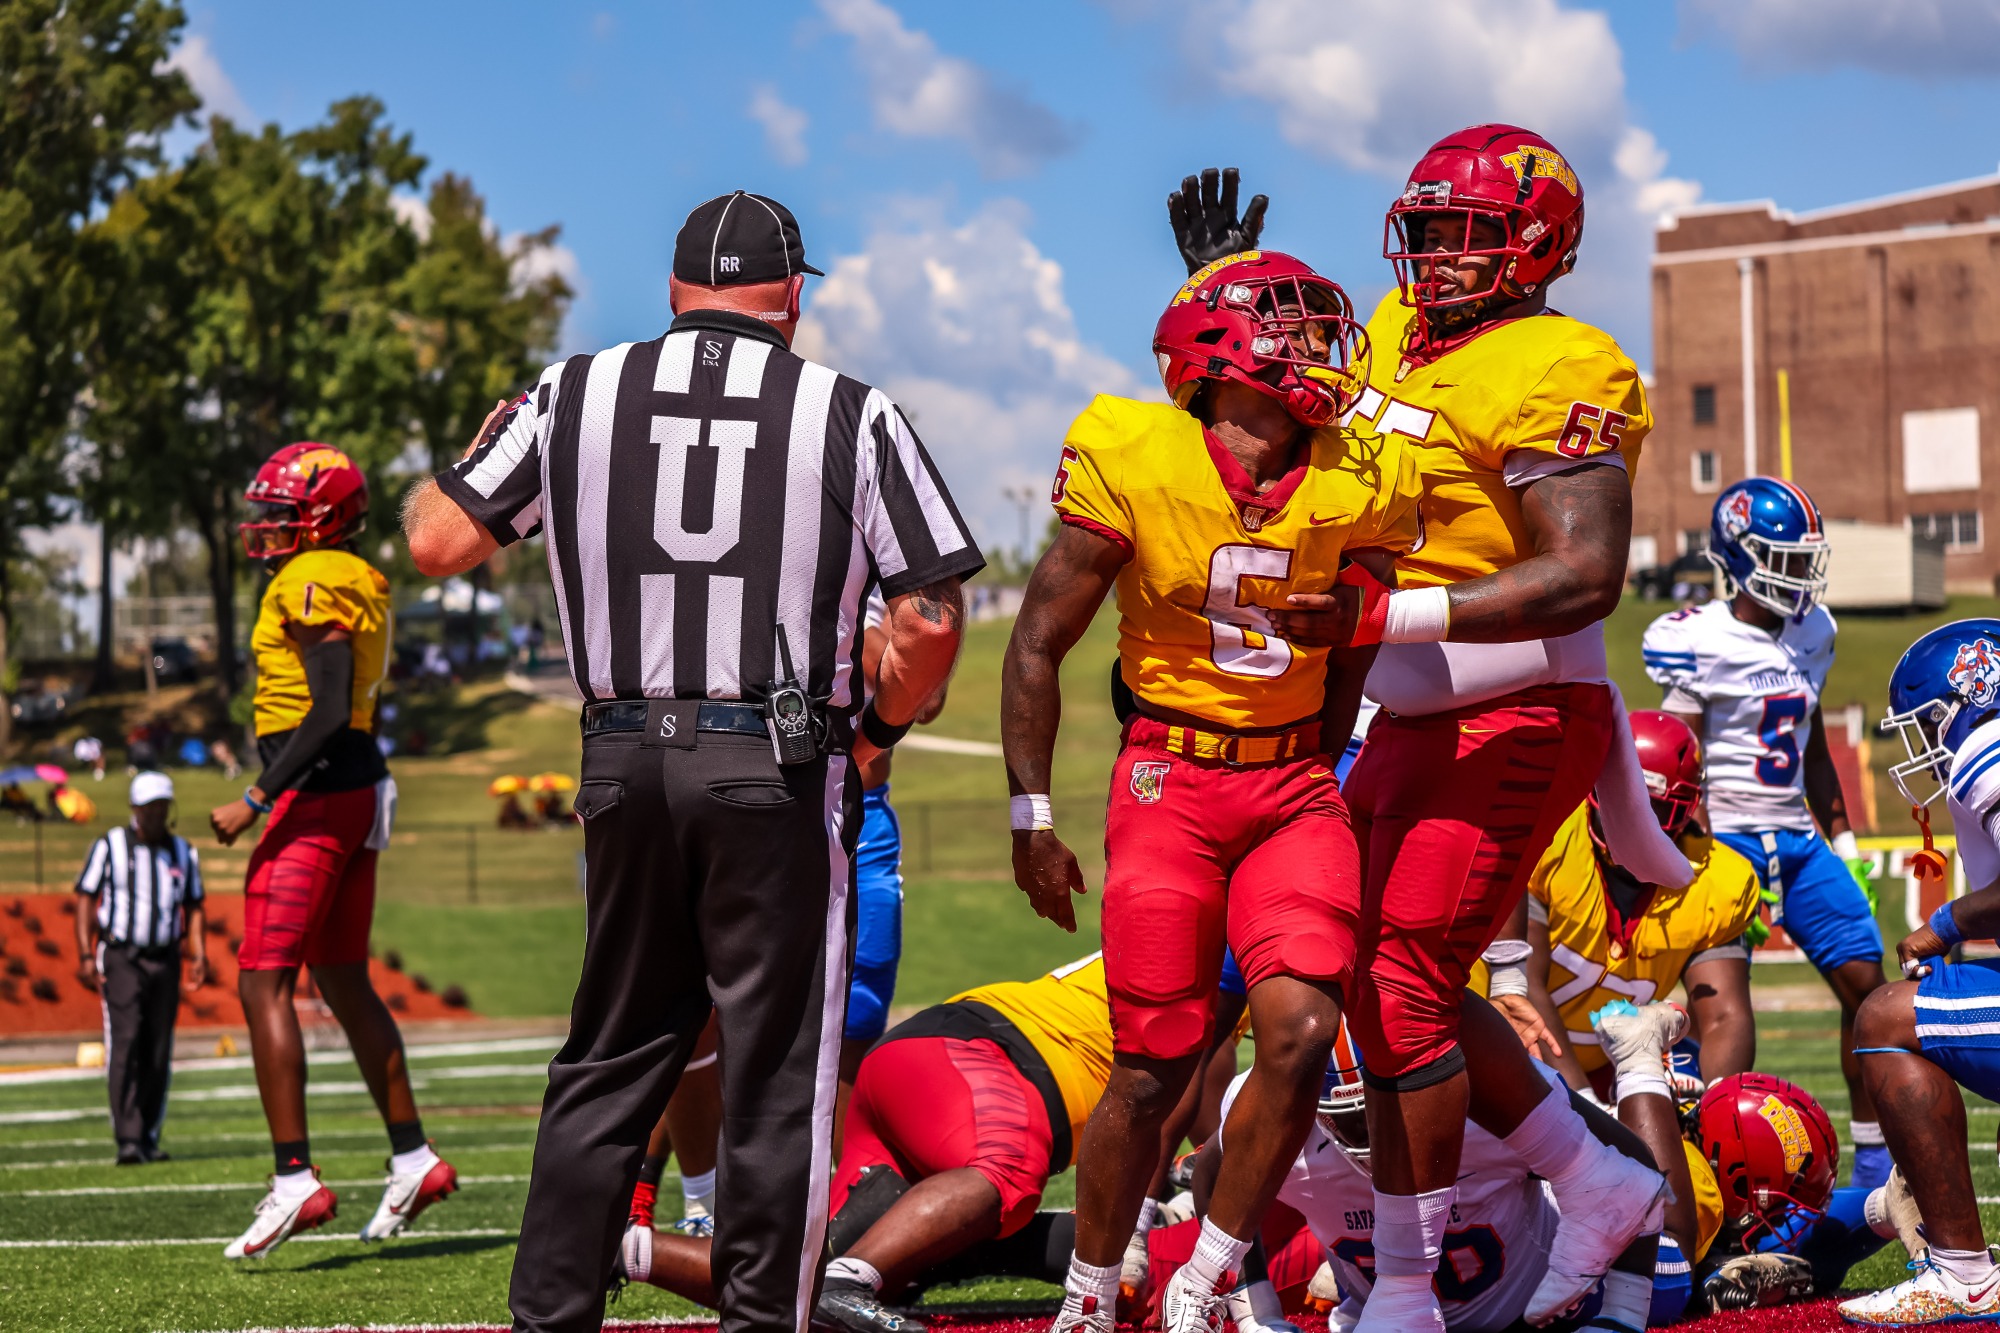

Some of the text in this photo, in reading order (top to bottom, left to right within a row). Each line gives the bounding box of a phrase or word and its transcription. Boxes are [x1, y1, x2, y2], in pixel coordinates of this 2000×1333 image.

[1500, 151, 1578, 197] TGERS
[720, 256, 741, 273] RR
[702, 359, 719, 367] USA
[1556, 400, 1628, 459] 65
[649, 415, 757, 562] U
[1201, 542, 1295, 680] 6
[1755, 693, 1808, 788] 5
[1334, 1087, 1364, 1098] Ridde
[1344, 1209, 1376, 1231] SAVA
